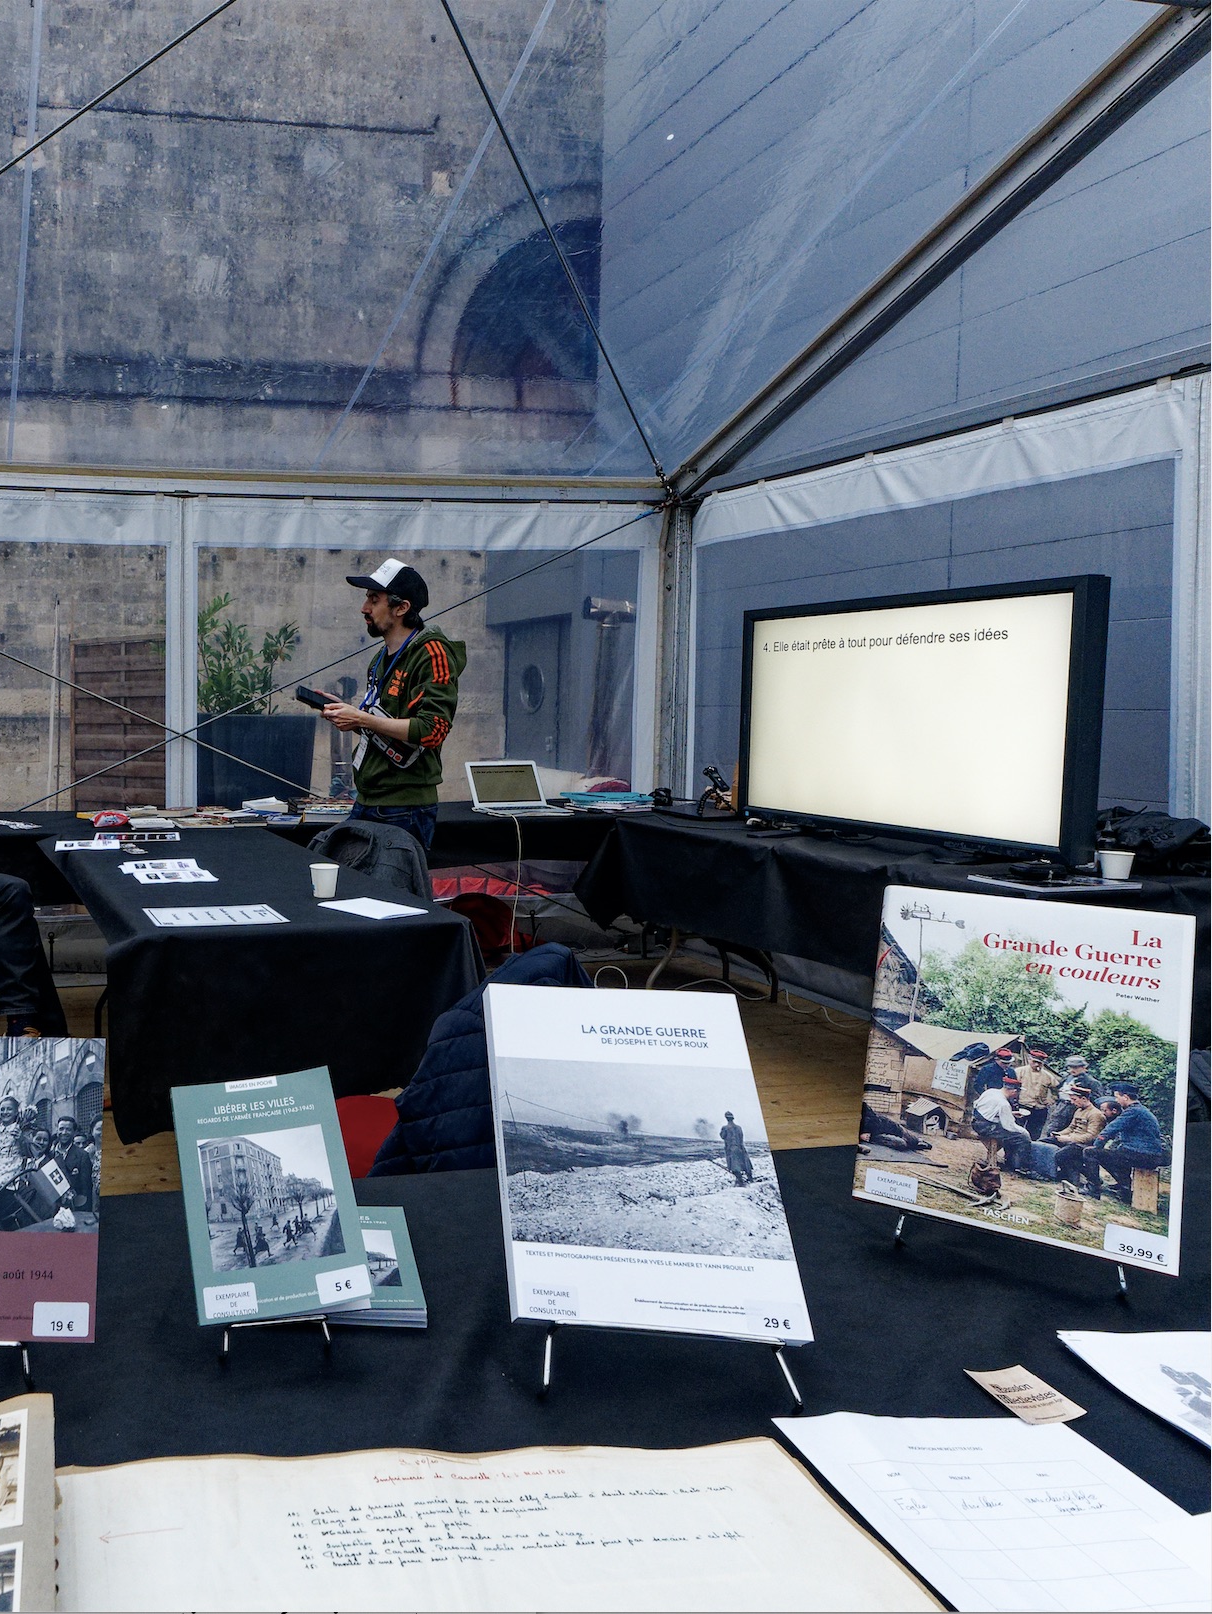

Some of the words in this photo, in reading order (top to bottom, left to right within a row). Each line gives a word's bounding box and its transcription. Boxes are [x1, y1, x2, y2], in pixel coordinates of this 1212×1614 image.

[763, 642, 771, 653] 4.
[773, 641, 789, 653] Elle
[791, 639, 811, 652] était
[812, 638, 836, 653] prête
[838, 636, 845, 648] à
[847, 636, 867, 649] tout
[869, 635, 893, 650] pour
[895, 631, 946, 647] défendre
[949, 630, 970, 643] ses
[974, 627, 1009, 642] idées
[1131, 929, 1163, 949] La
[983, 932, 1069, 959] Grande
[1075, 942, 1162, 969] Guerre
[1025, 960, 1054, 976] en
[1059, 962, 1161, 991] couleurs
[1116, 991, 1132, 1000] Peter
[1134, 994, 1160, 1004] Walther
[581, 1024, 597, 1035] LA
[600, 1025, 653, 1038] GRANDE
[655, 1027, 706, 1040] GUERRE
[601, 1037, 612, 1045] DE
[614, 1038, 647, 1047] JOSEPH
[648, 1039, 658, 1047] ET
[660, 1039, 682, 1048] LOYS
[684, 1040, 709, 1050] ROUX
[229, 1082, 247, 1090] IMAGES
[255, 1079, 273, 1087] POCHE
[213, 1100, 248, 1115] LIBÉRER
[250, 1101, 266, 1111] LES
[266, 1096, 295, 1109] VILLES
[197, 1116, 222, 1125] REGARDS
[253, 1109, 282, 1119] FRANÇAISE
[876, 1175, 913, 1189] EXEMPLAIRE
[871, 1188, 916, 1204] CONSULTATION
[983, 1206, 1030, 1225] TASCHEN
[555, 1252, 603, 1262] PHOTOGRAPHIES
[1119, 1242, 1153, 1260] 39,99
[1157, 1252, 1165, 1263] €
[2, 1268, 25, 1280] août
[29, 1270, 53, 1281] 1944
[335, 1281, 342, 1292] 5
[345, 1279, 352, 1290] €
[215, 1291, 251, 1301] EXEMPLAIRE
[532, 1288, 570, 1298] EXEMPLAIRE
[548, 1298, 556, 1306] DE
[213, 1308, 258, 1318] CONSULTATION
[529, 1306, 577, 1317] CONSULTATION
[50, 1320, 63, 1332] 19
[66, 1320, 74, 1332] €
[763, 1317, 779, 1329] 29
[783, 1319, 791, 1330] €
